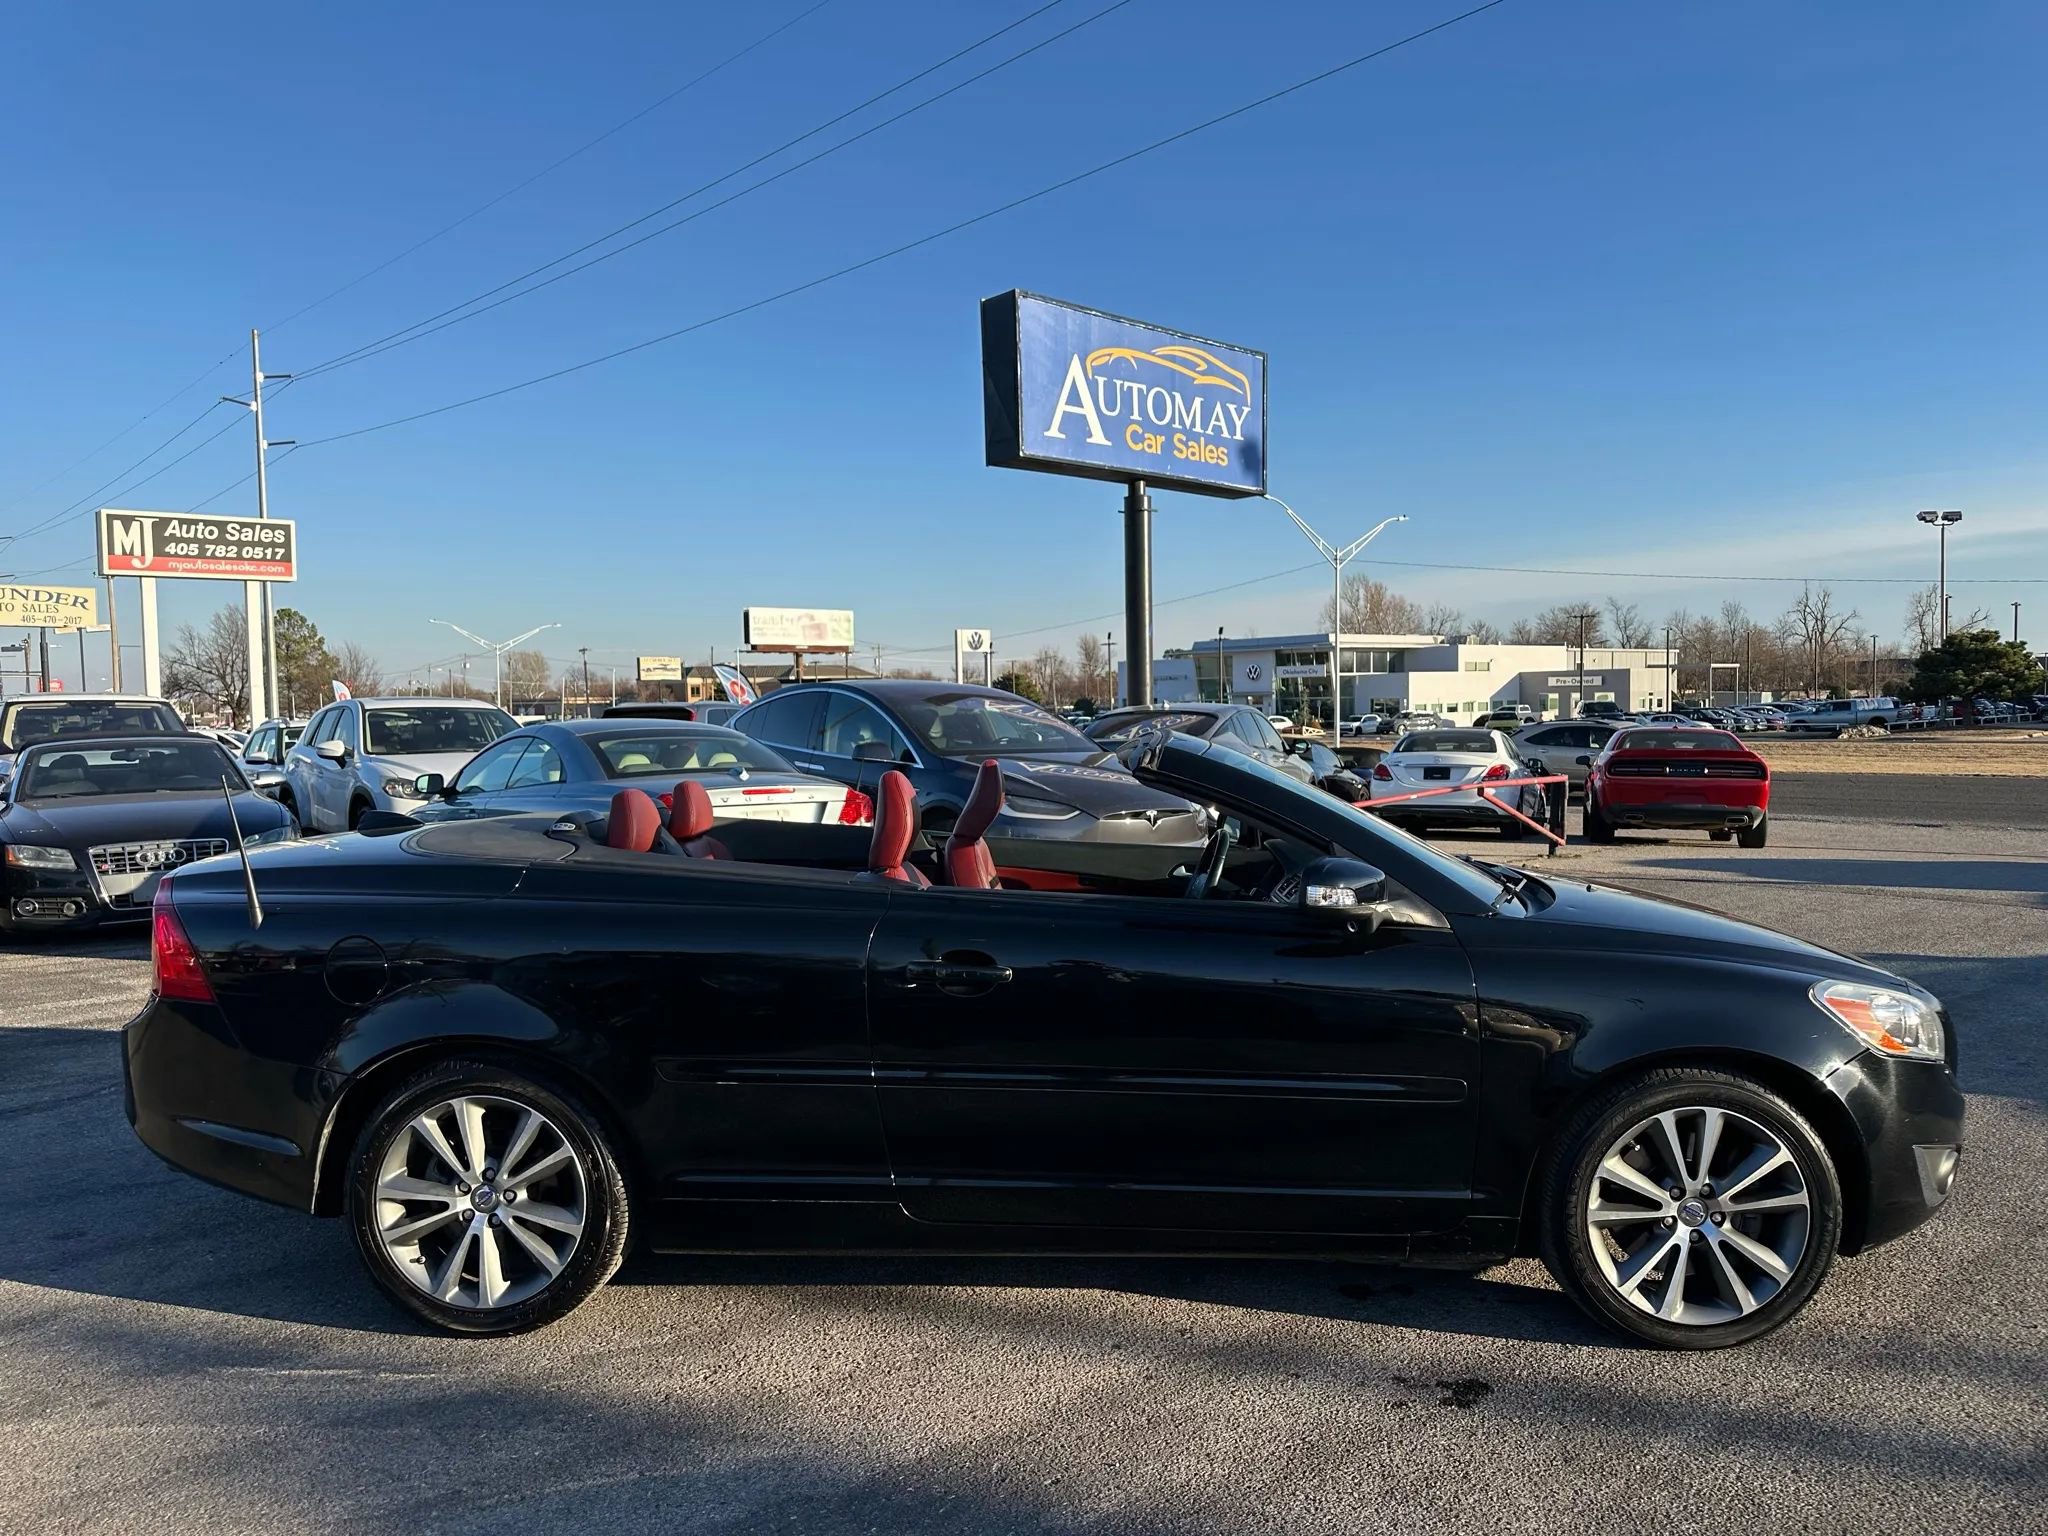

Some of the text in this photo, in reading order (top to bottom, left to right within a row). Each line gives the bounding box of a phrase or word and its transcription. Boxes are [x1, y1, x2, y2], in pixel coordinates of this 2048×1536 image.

[1044, 353, 1251, 446] AUTOMAY
[1125, 424, 1229, 467] Car Sales
[164, 519, 286, 543] Auto Sales
[112, 517, 160, 569] MJ
[165, 542, 286, 560] 405 782 0517
[168, 560, 286, 574] mjautosalesokc.com
[21, 603, 60, 614] SALES
[20, 614, 82, 625] 405-470-2017
